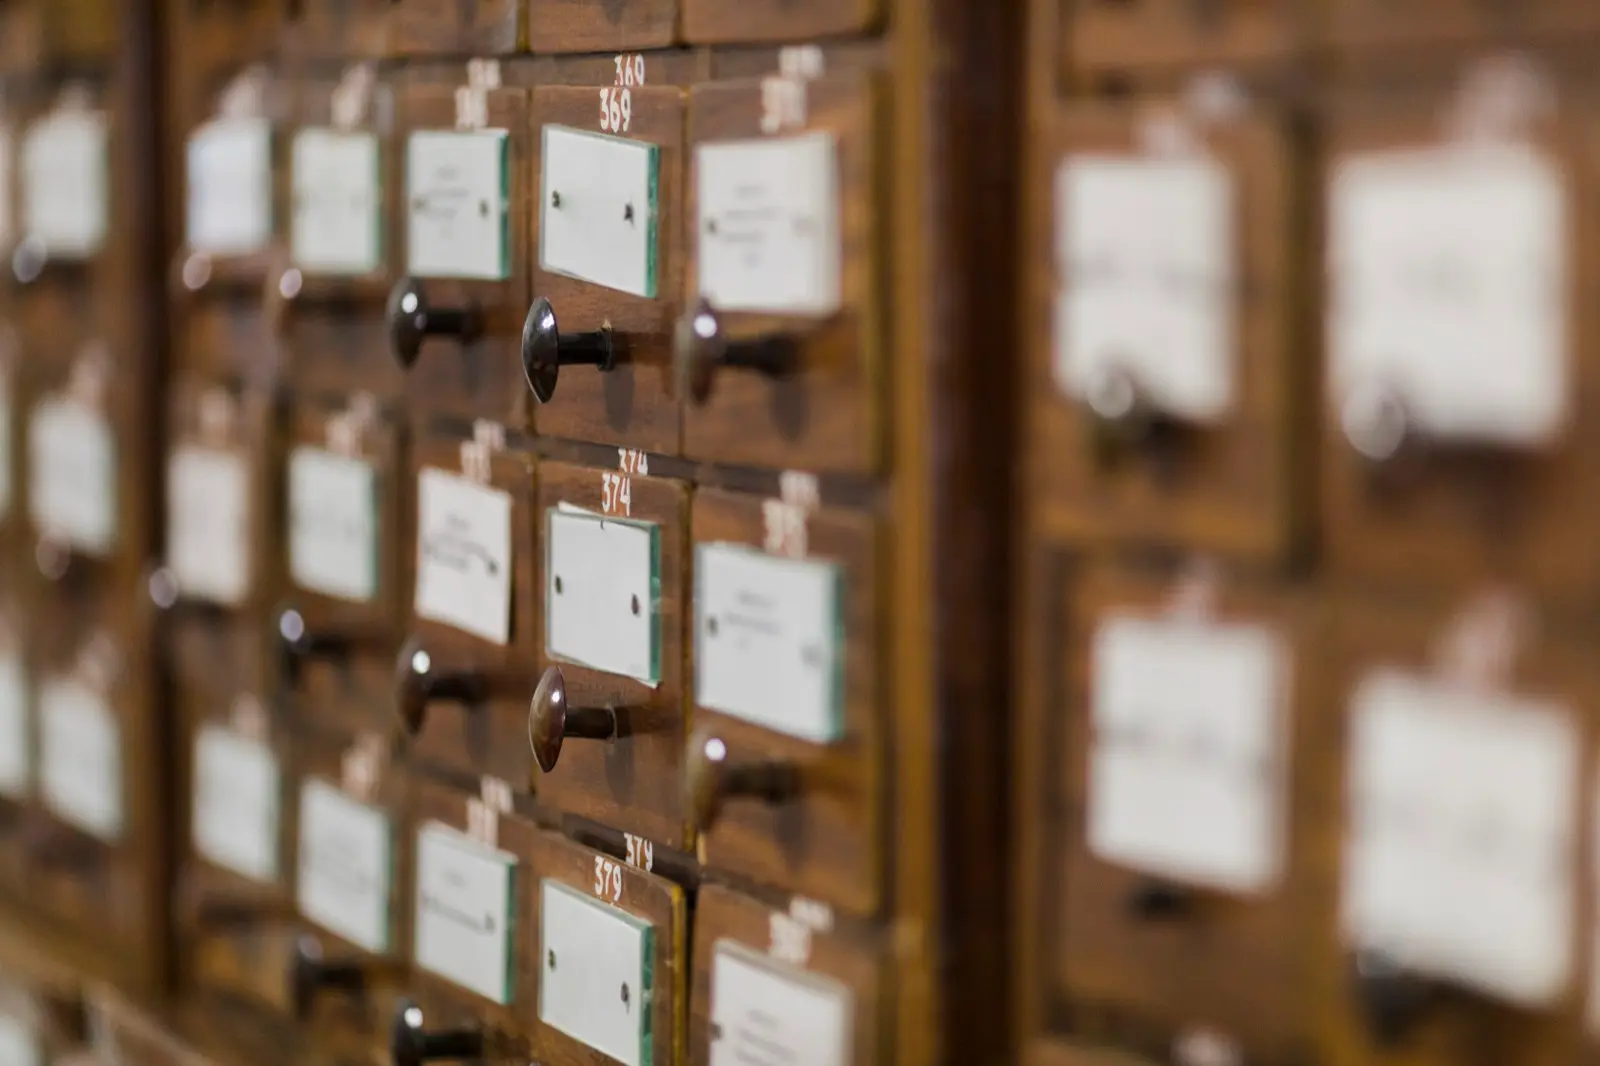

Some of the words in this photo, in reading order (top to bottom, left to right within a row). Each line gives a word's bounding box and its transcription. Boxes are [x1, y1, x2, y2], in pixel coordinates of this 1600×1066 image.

[600, 87, 631, 133] 369
[618, 448, 648, 476] 374
[602, 472, 631, 517] 374
[624, 832, 653, 872] 379
[594, 855, 622, 902] 379
